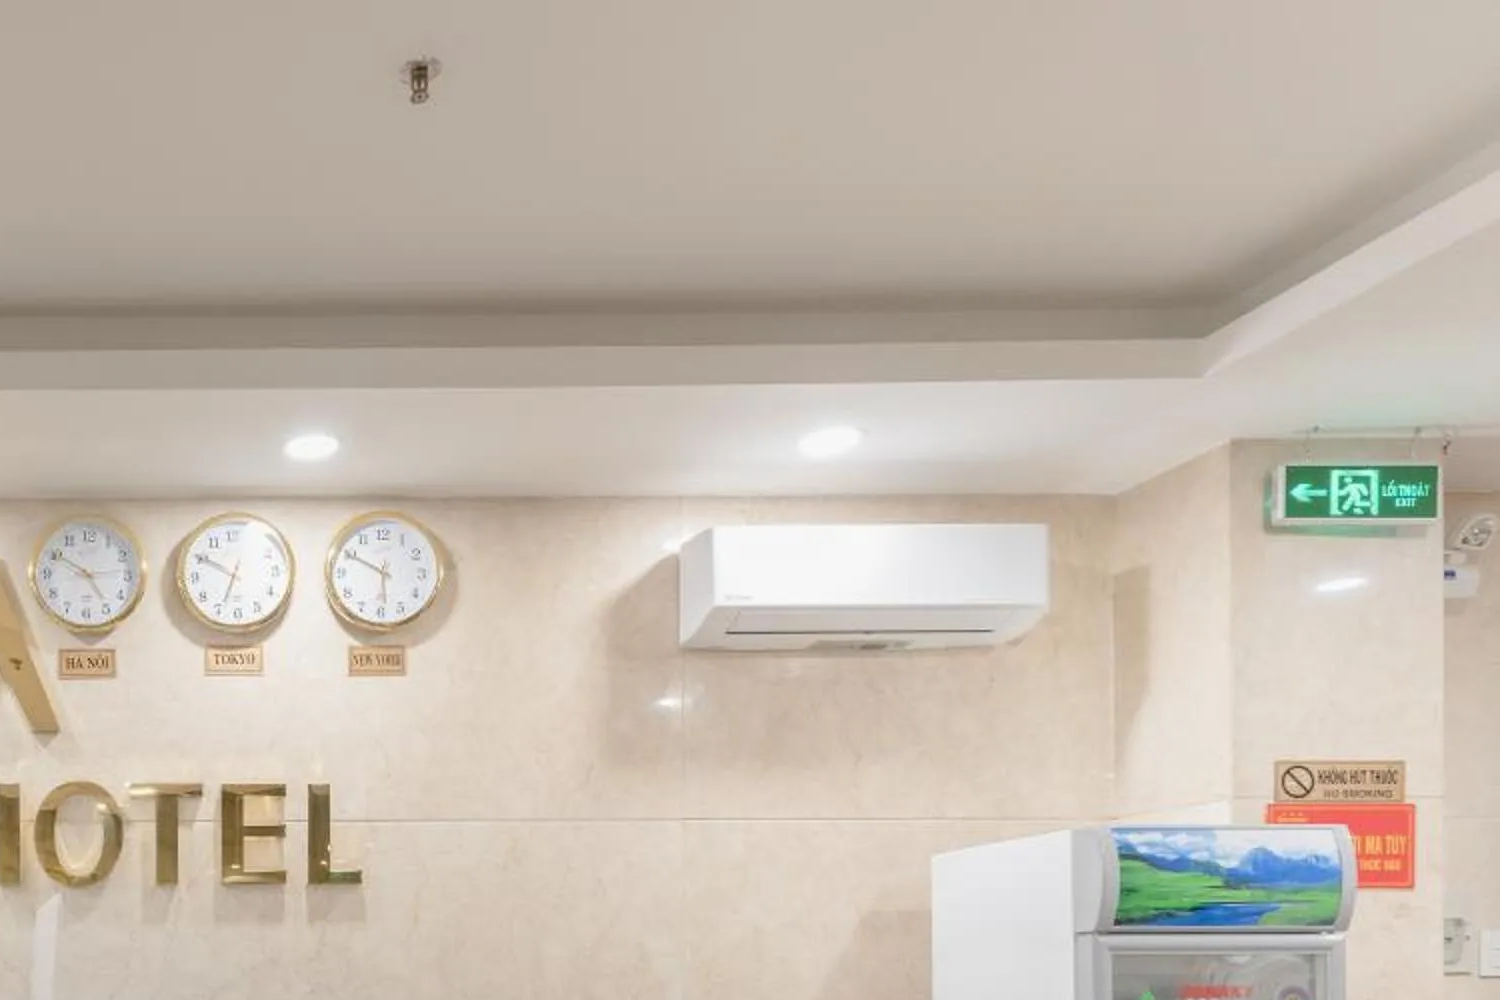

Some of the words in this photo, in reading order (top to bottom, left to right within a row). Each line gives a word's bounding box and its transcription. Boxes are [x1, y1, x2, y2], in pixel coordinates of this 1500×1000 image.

[1395, 497, 1417, 507] EXIT
[83, 530, 97, 543] 12
[377, 528, 390, 541] 12
[214, 653, 256, 665] TOKYO
[1323, 788, 1339, 798] NO
[1343, 788, 1394, 798] SMOKING
